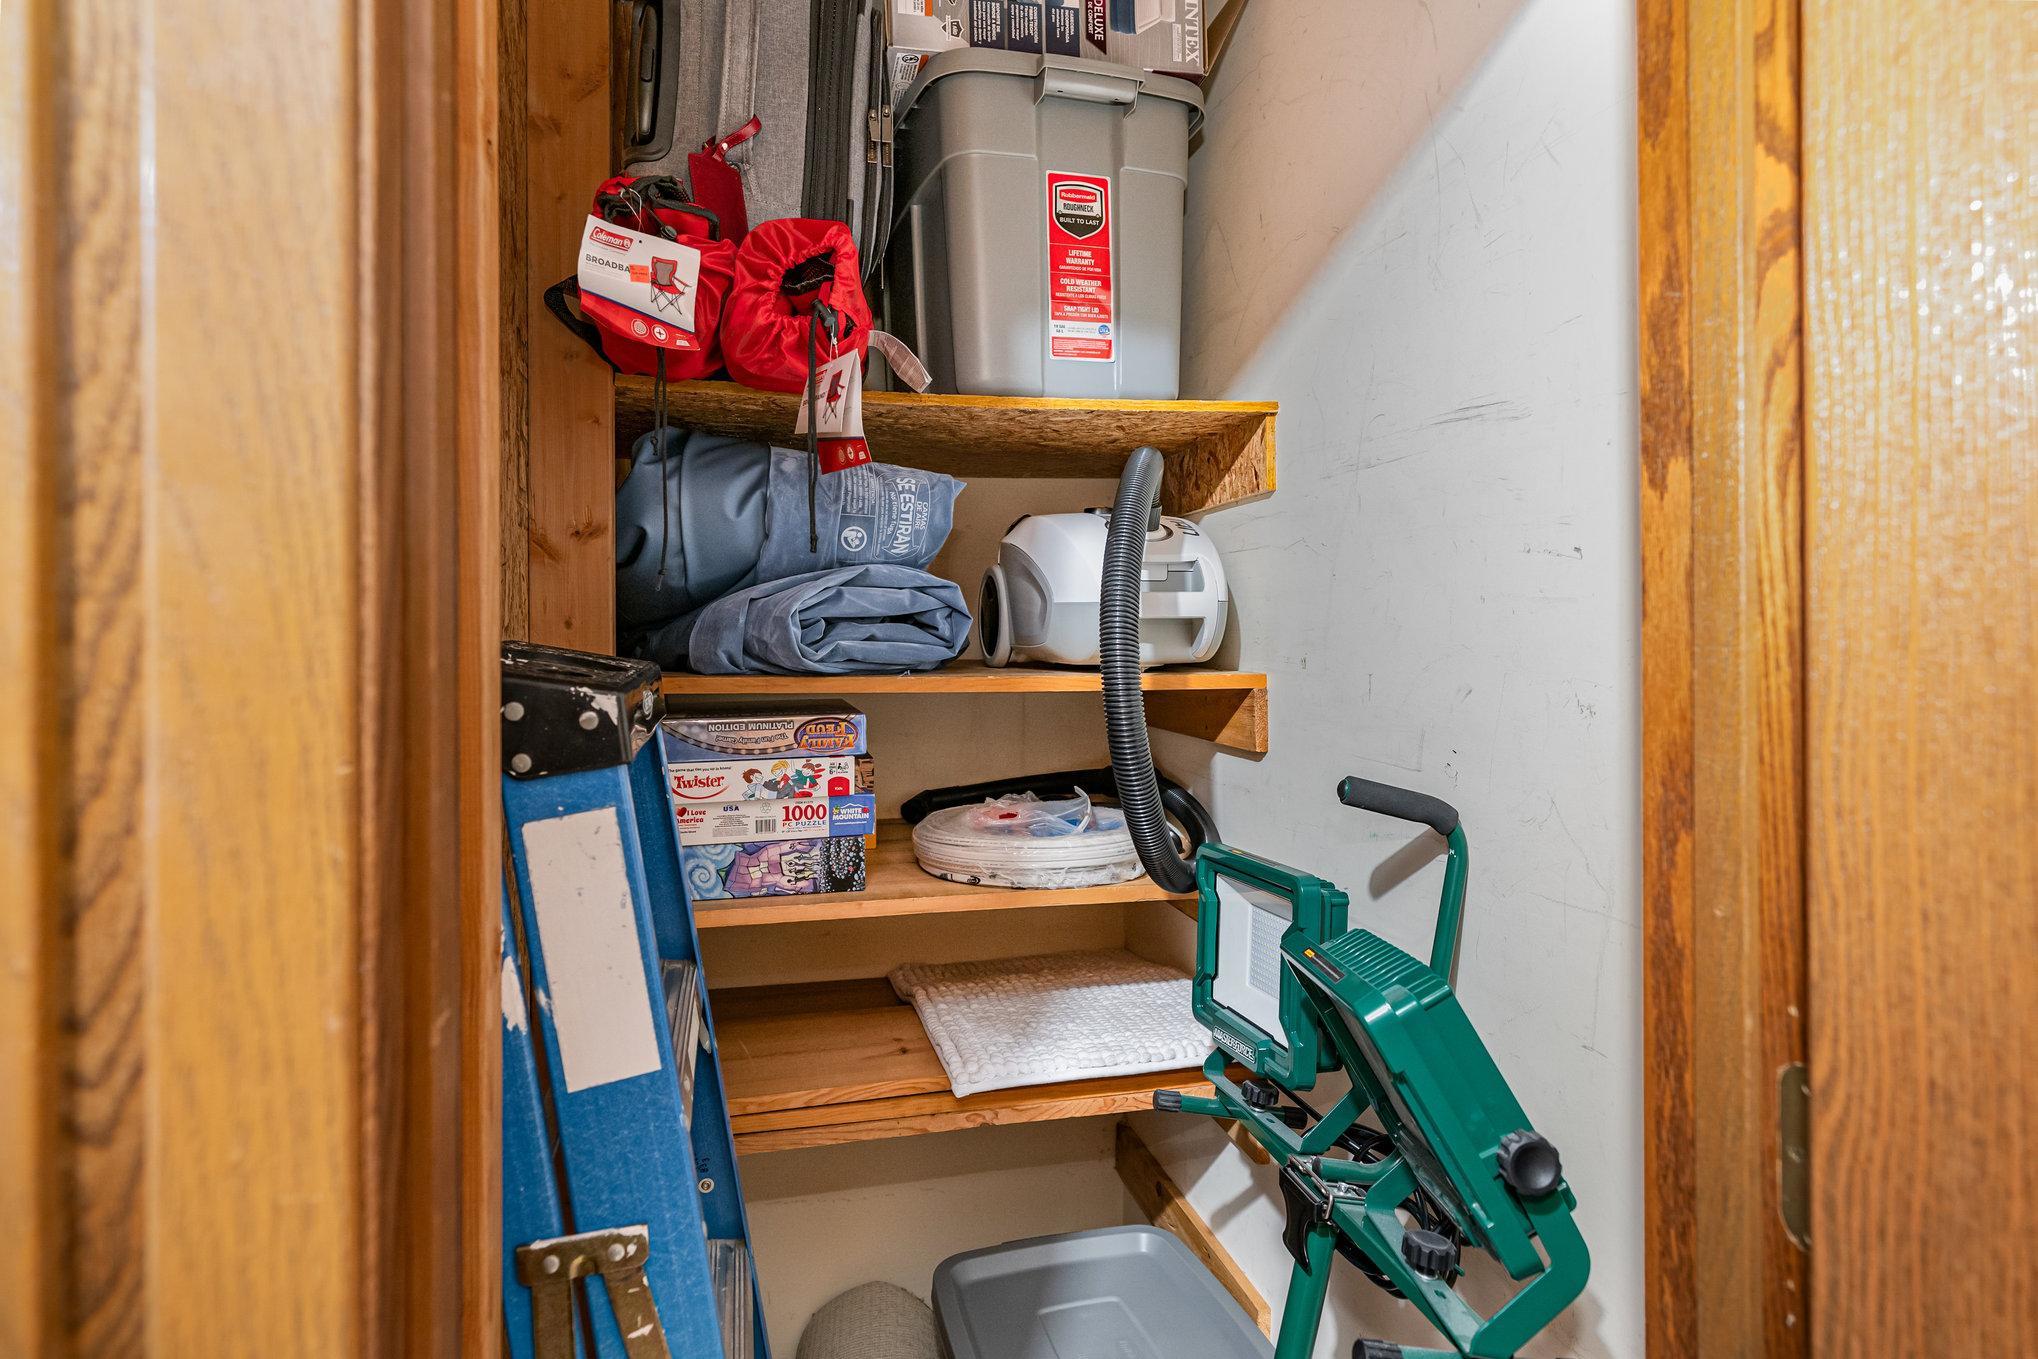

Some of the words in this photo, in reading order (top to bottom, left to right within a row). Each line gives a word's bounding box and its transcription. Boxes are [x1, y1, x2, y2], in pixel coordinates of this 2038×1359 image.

[1088, 1, 1093, 9] DE
[1094, 0, 1104, 40] DELUXE
[1185, 0, 1200, 66] INTEX
[1061, 192, 1096, 200] Rubbermaid
[1063, 203, 1094, 212] ROUGHNECK
[593, 228, 623, 246] Coleman
[1068, 249, 1092, 257] LIFETIME
[1065, 257, 1095, 266] WARRANTY
[1075, 279, 1102, 287] WEATHER
[896, 478, 916, 492] SE
[891, 501, 899, 520] tiene
[916, 501, 923, 511] DE
[919, 501, 929, 530] CAMAS
[891, 493, 915, 554] ESTIRAN
[708, 723, 746, 732] EDITION
[748, 721, 794, 730] PLATINUM
[806, 721, 848, 736] FEUD
[738, 736, 761, 744] Family
[799, 734, 855, 750] FAMILY
[674, 775, 725, 789] Twister
[782, 804, 827, 821] 1000
[1213, 1028, 1255, 1060] MASTERFORCE
